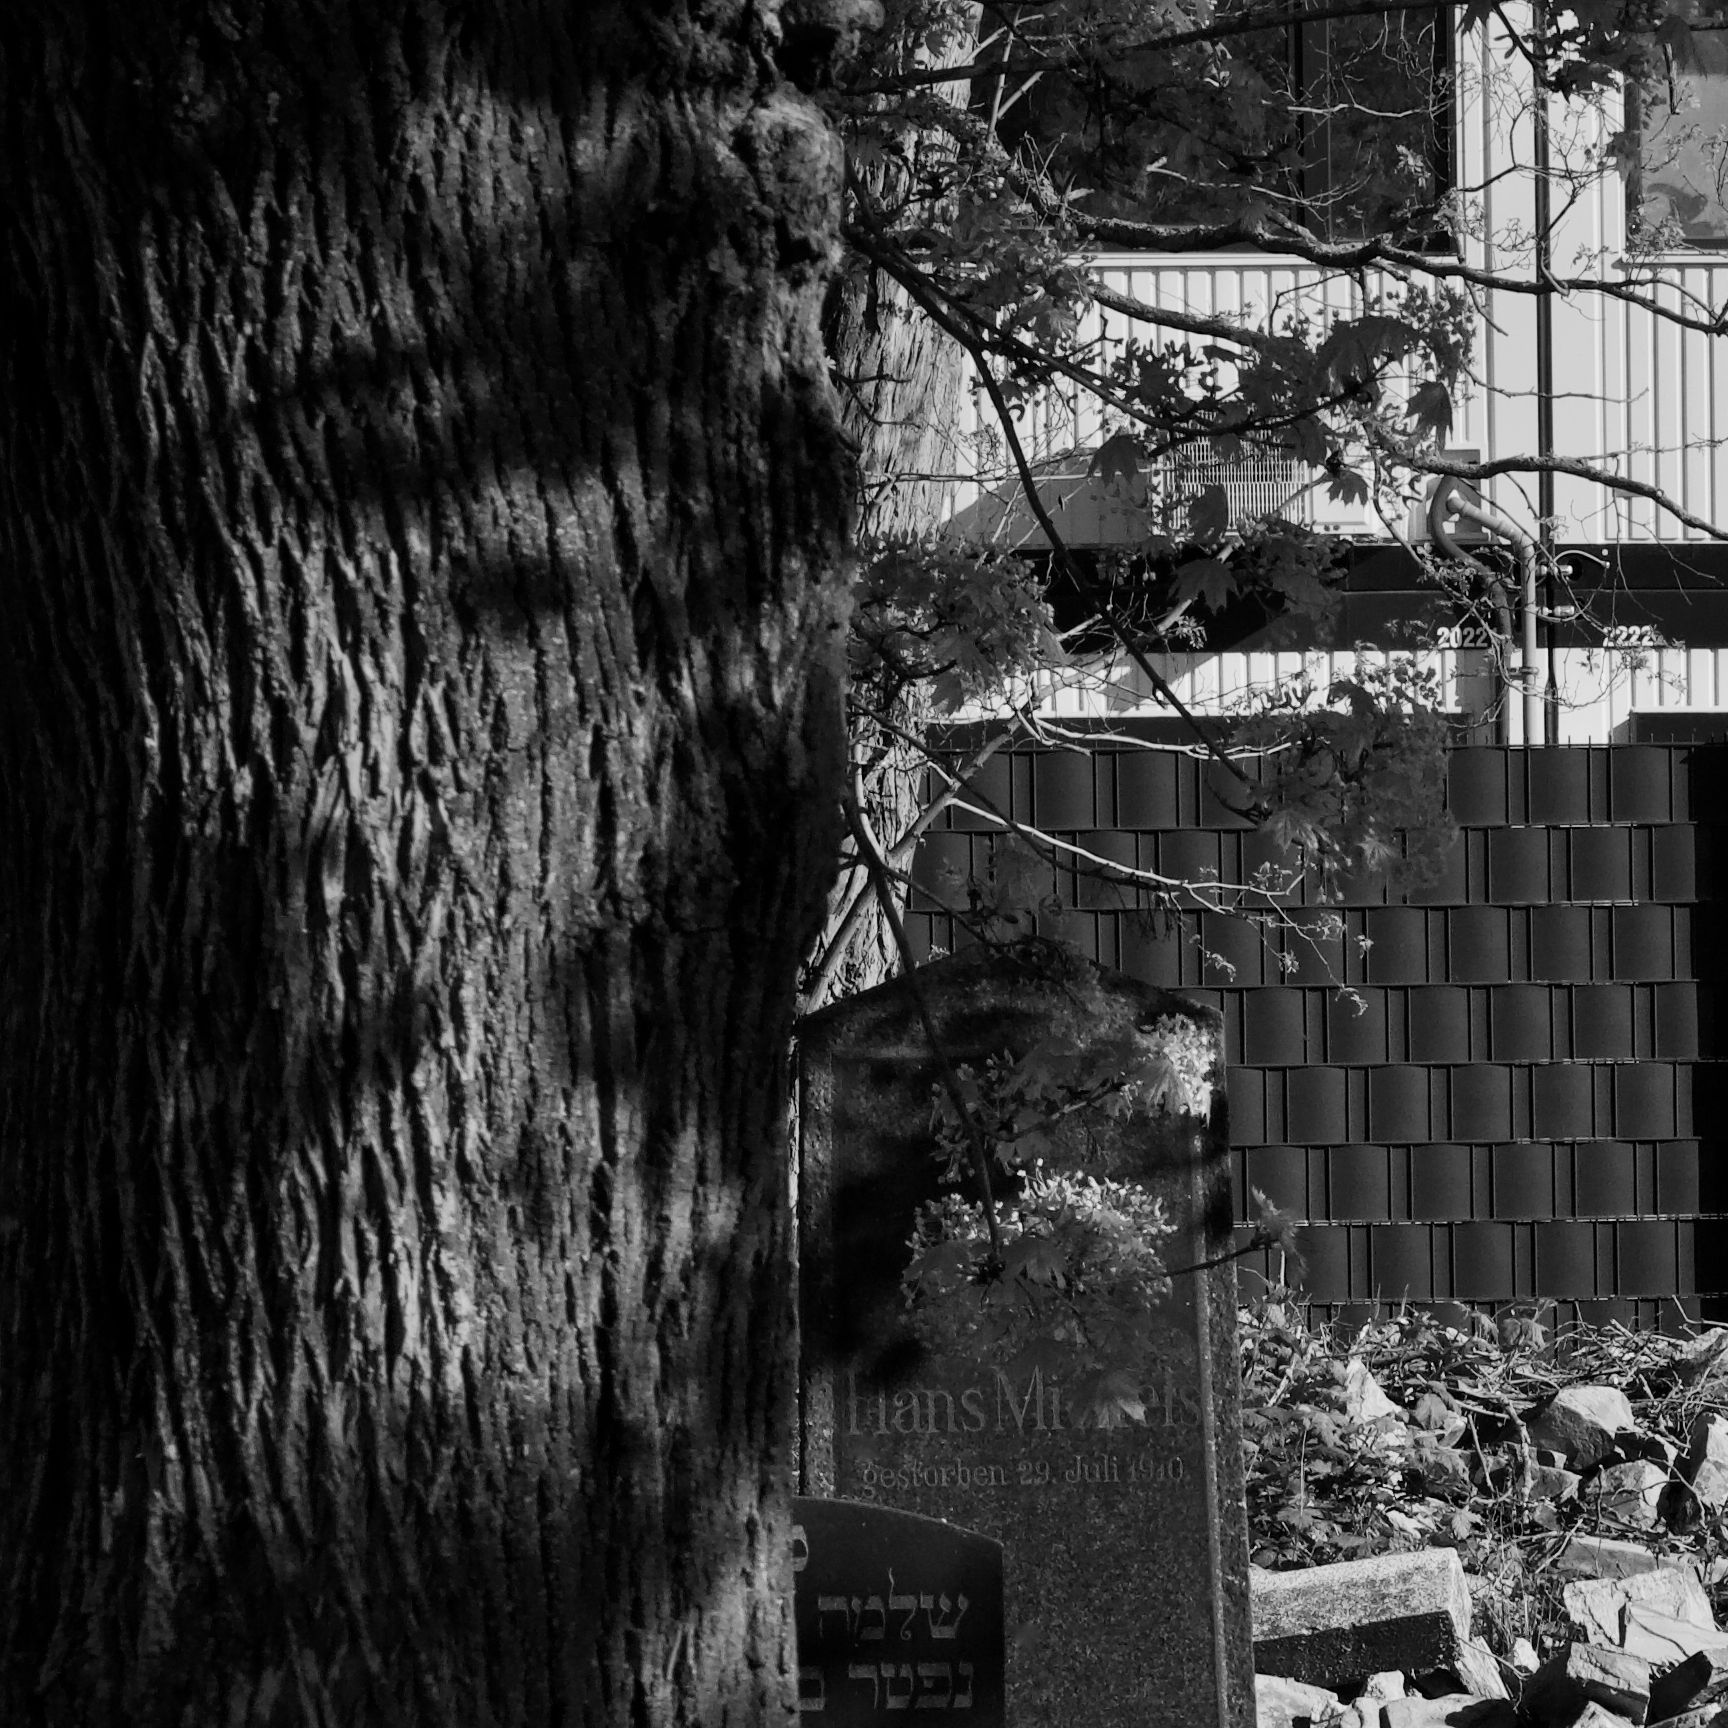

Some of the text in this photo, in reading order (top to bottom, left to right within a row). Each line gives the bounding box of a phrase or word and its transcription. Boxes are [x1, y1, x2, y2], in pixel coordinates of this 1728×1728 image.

[848, 1367, 987, 1436] Hans
[860, 1456, 1008, 1499] gestorben
[1065, 1454, 1120, 1485] Juli
